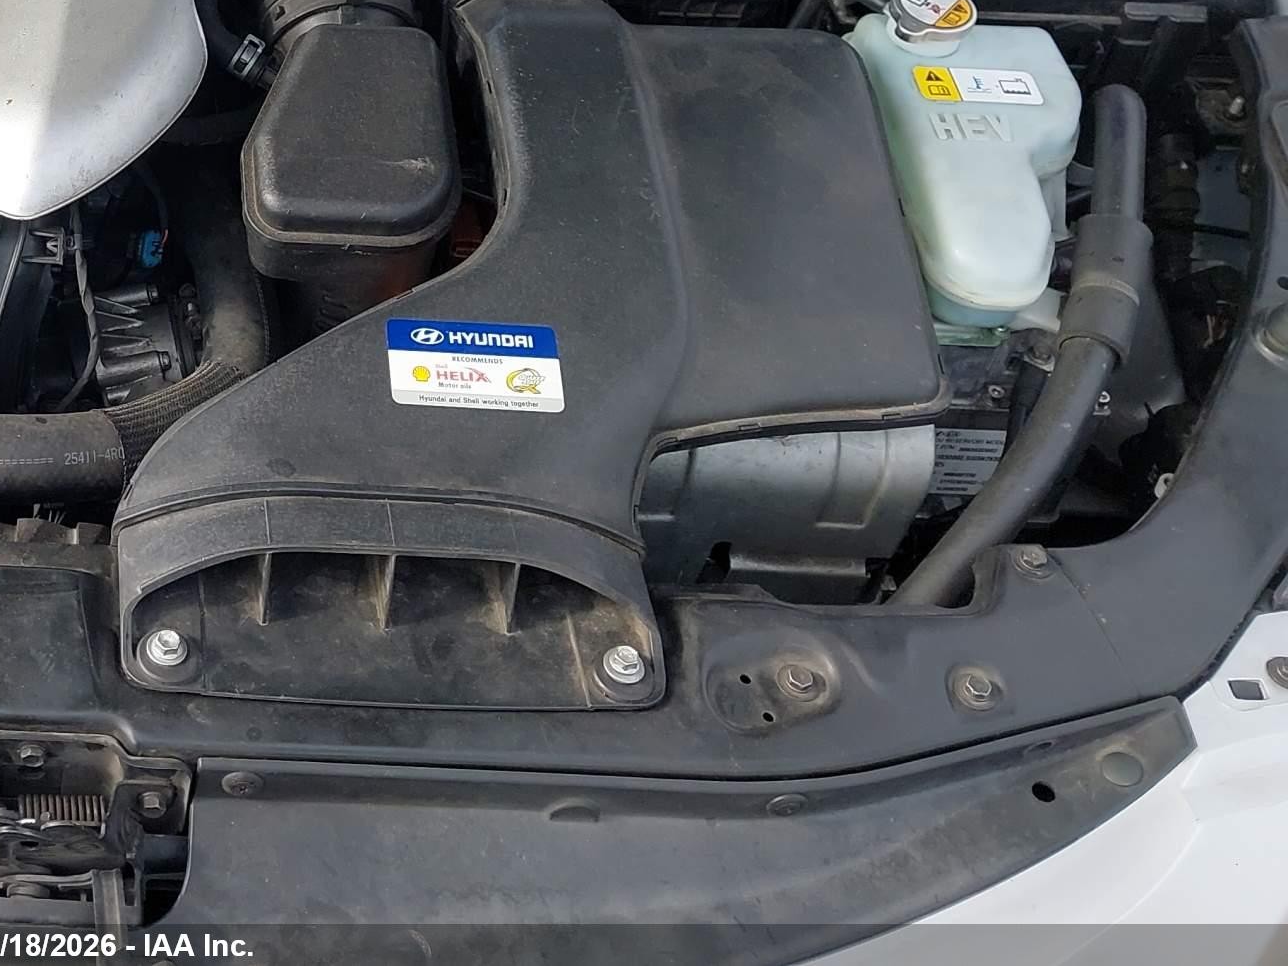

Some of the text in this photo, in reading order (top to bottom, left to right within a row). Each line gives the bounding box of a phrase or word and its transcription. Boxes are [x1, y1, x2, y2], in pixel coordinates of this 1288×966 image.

[929, 113, 1012, 143] HEV
[448, 330, 534, 348] HYUNDAI
[451, 355, 504, 365] RECOMMENDS
[436, 367, 491, 383] HELIX
[419, 394, 540, 410] Hyundai and Shell working together
